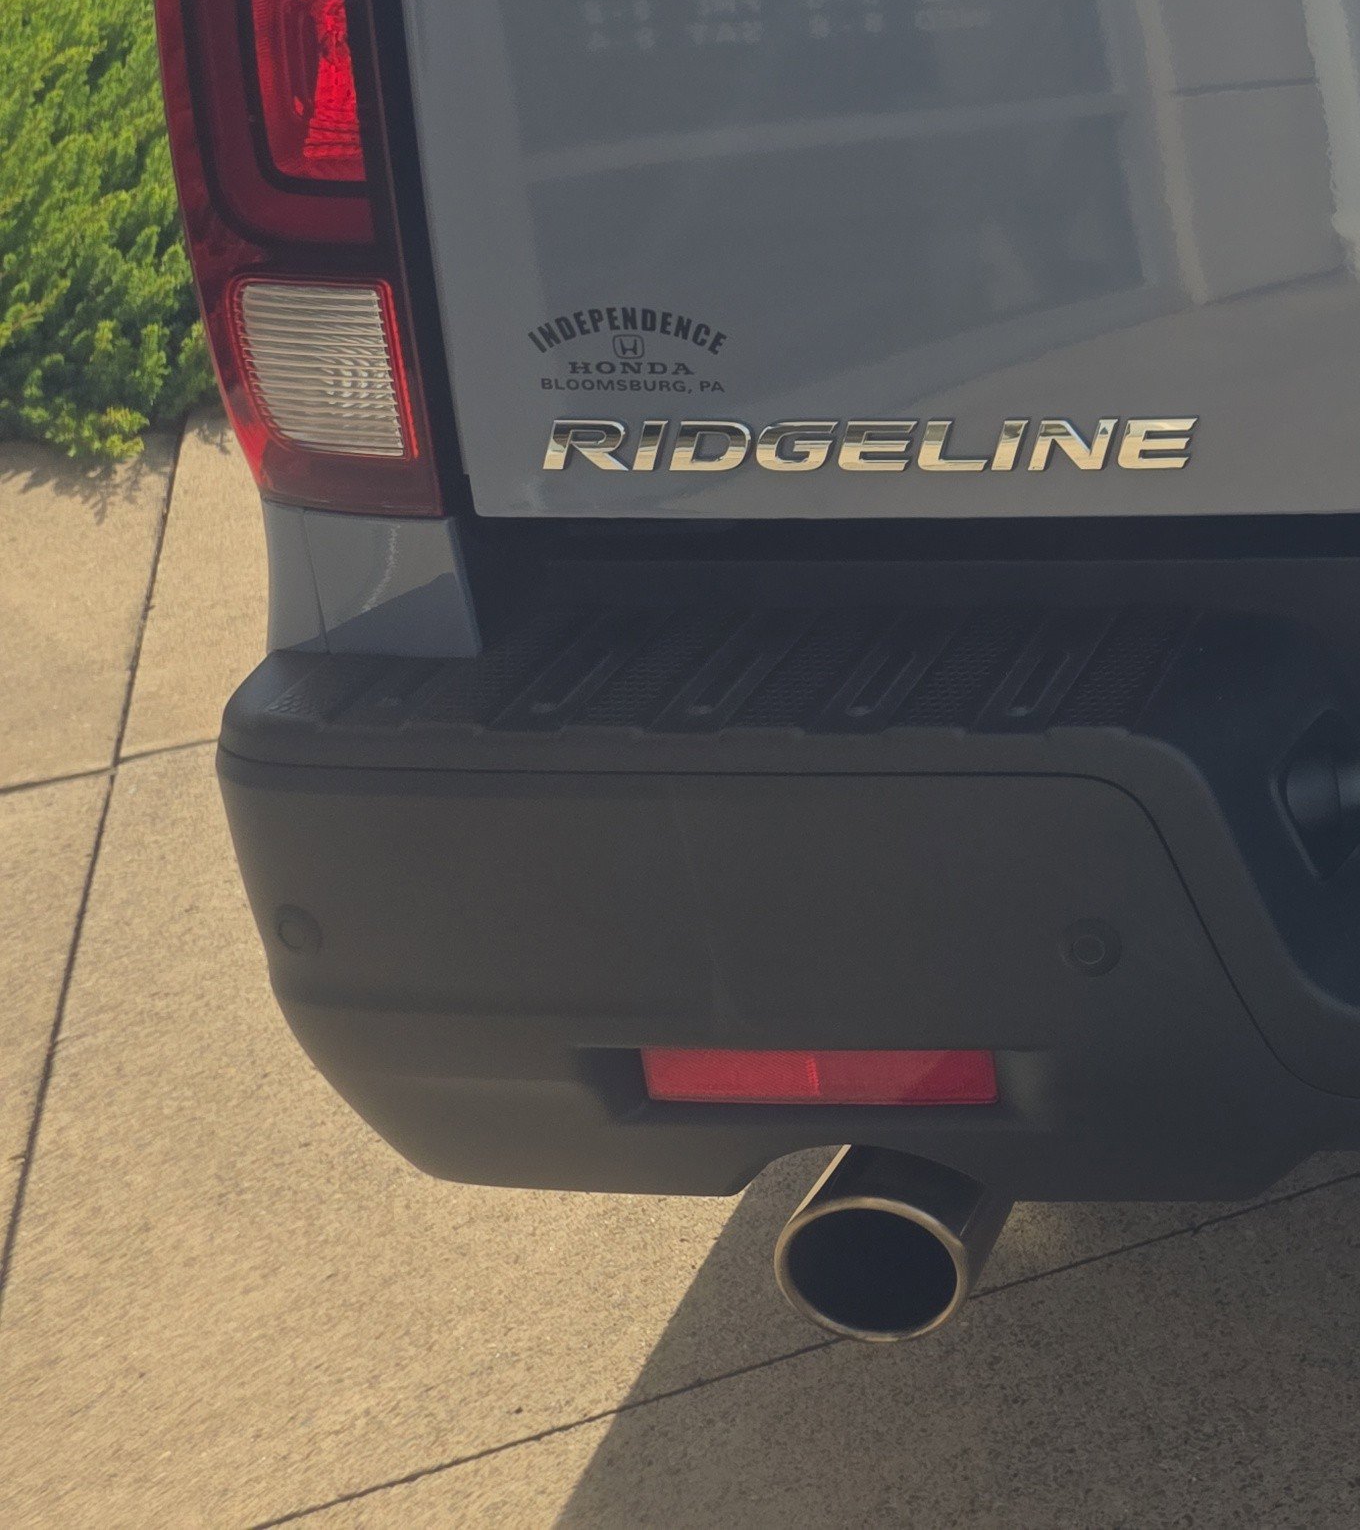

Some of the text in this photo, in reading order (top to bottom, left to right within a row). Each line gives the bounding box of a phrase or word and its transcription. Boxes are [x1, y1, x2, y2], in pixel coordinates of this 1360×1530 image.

[528, 307, 727, 355] INDEPENDENCE
[568, 361, 695, 375] HONDA
[541, 378, 725, 394] BLOOMSBURG, PA
[541, 416, 1199, 471] RIDGELINE
